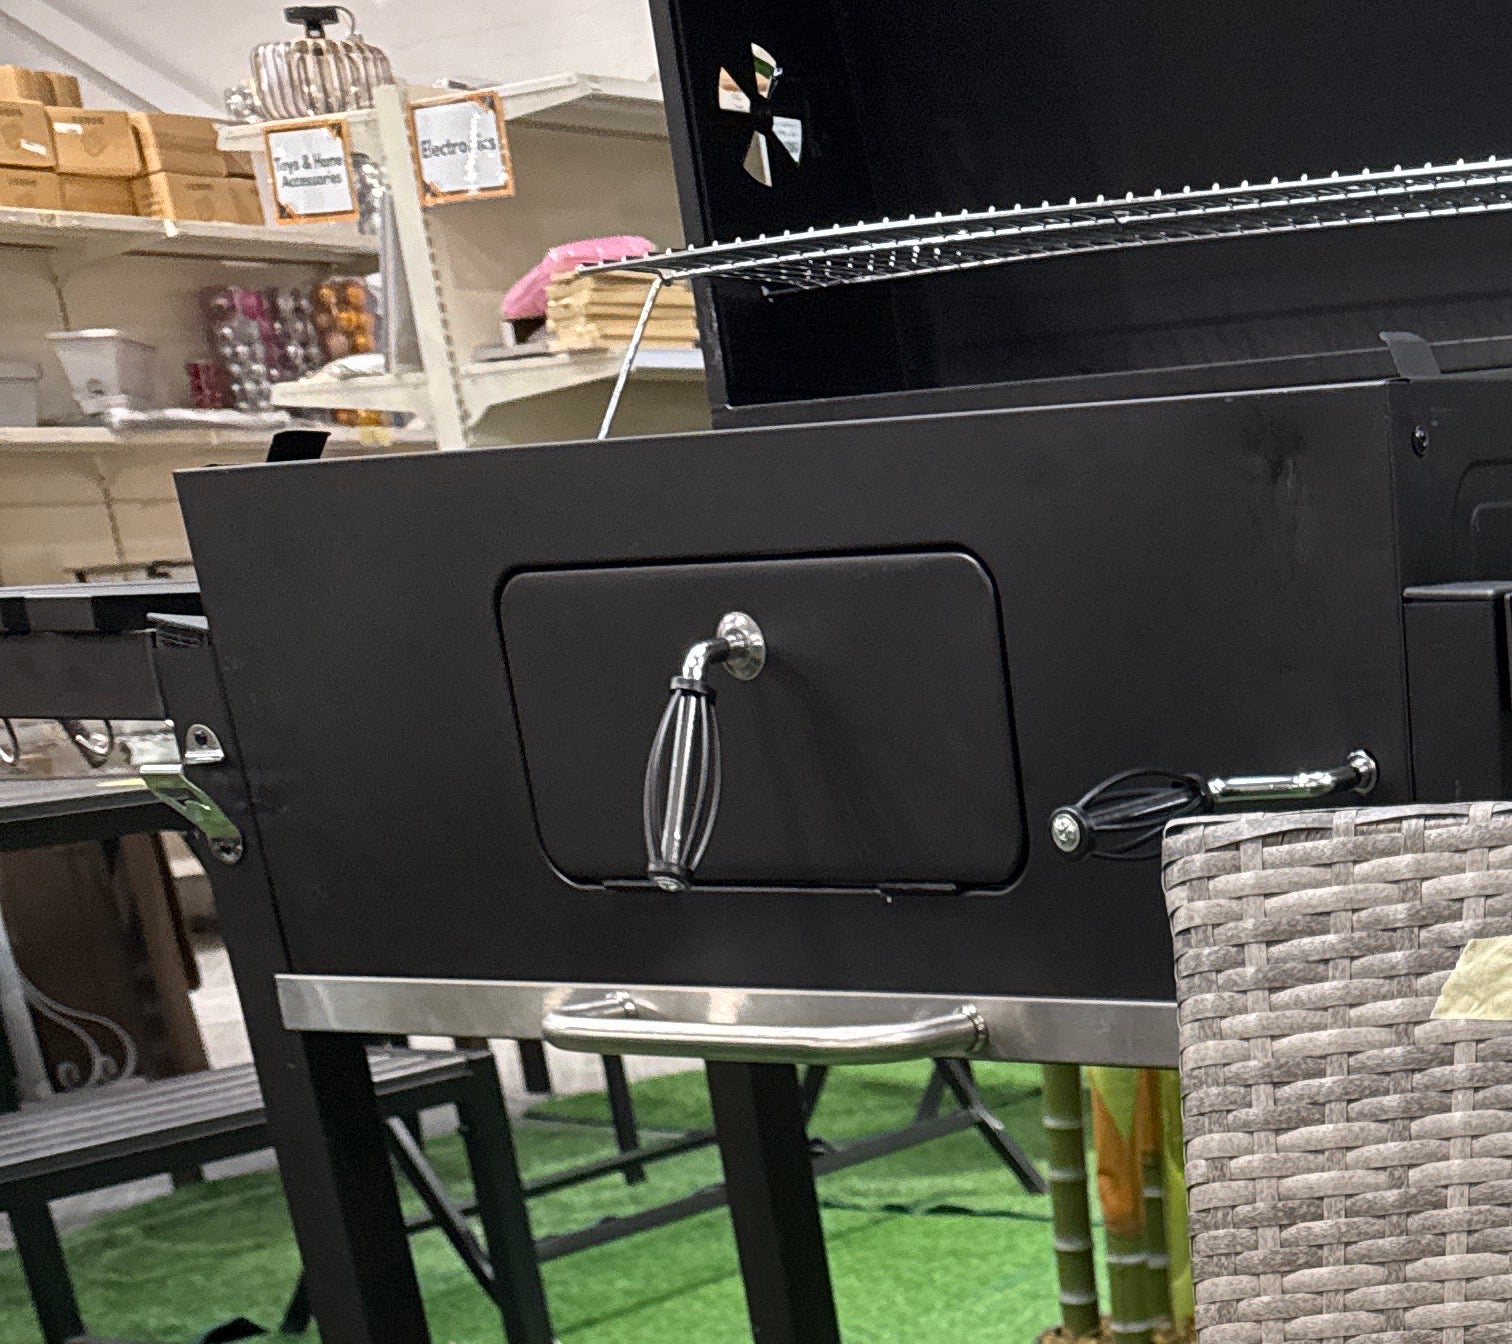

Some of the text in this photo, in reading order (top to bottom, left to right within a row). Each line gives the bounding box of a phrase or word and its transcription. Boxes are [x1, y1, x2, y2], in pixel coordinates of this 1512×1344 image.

[421, 136, 496, 159] Electroics
[302, 154, 313, 171] &
[313, 153, 343, 168] Home
[282, 173, 342, 189] Accessories
